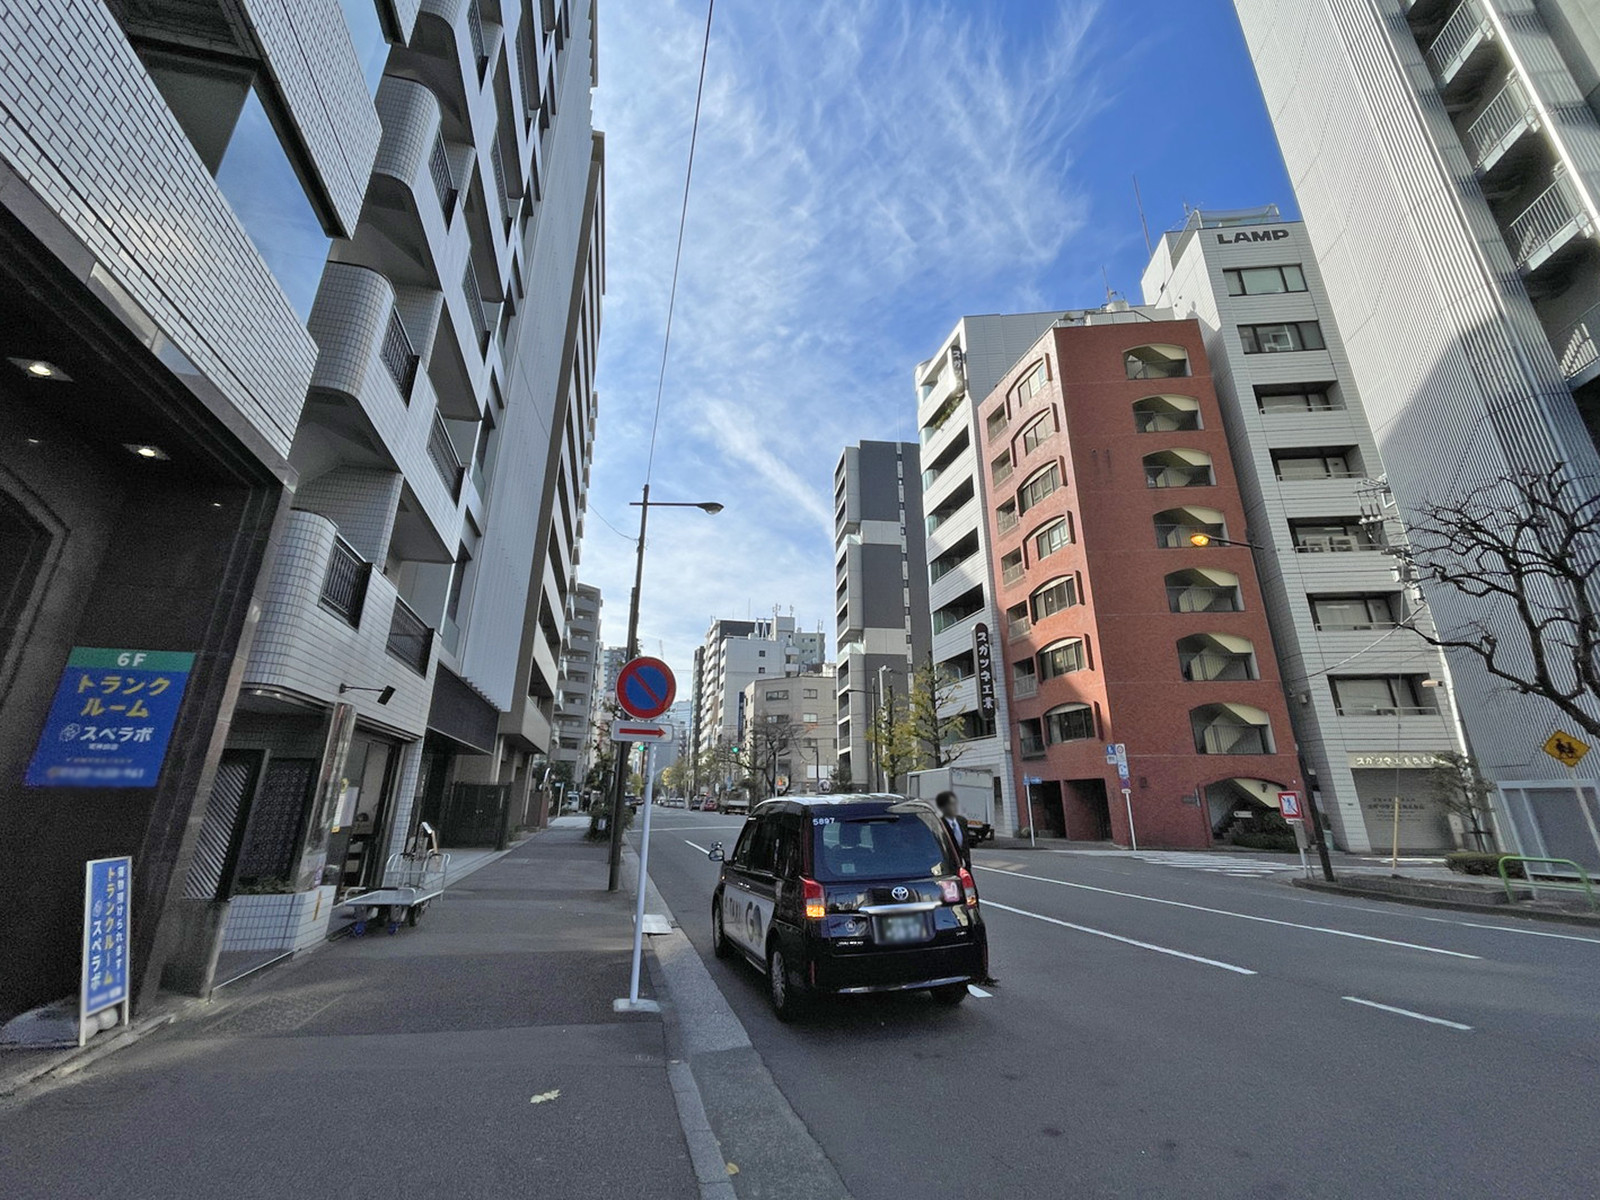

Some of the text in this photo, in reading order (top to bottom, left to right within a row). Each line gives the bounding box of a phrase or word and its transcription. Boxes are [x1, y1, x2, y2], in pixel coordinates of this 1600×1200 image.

[1217, 229, 1289, 244] LAMP
[117, 653, 147, 667] 6F
[977, 632, 993, 709] スガツネ工業
[77, 674, 170, 696] トランク
[80, 698, 149, 718] ルーム
[812, 817, 836, 826] 5897
[103, 866, 115, 985] トランクルーム
